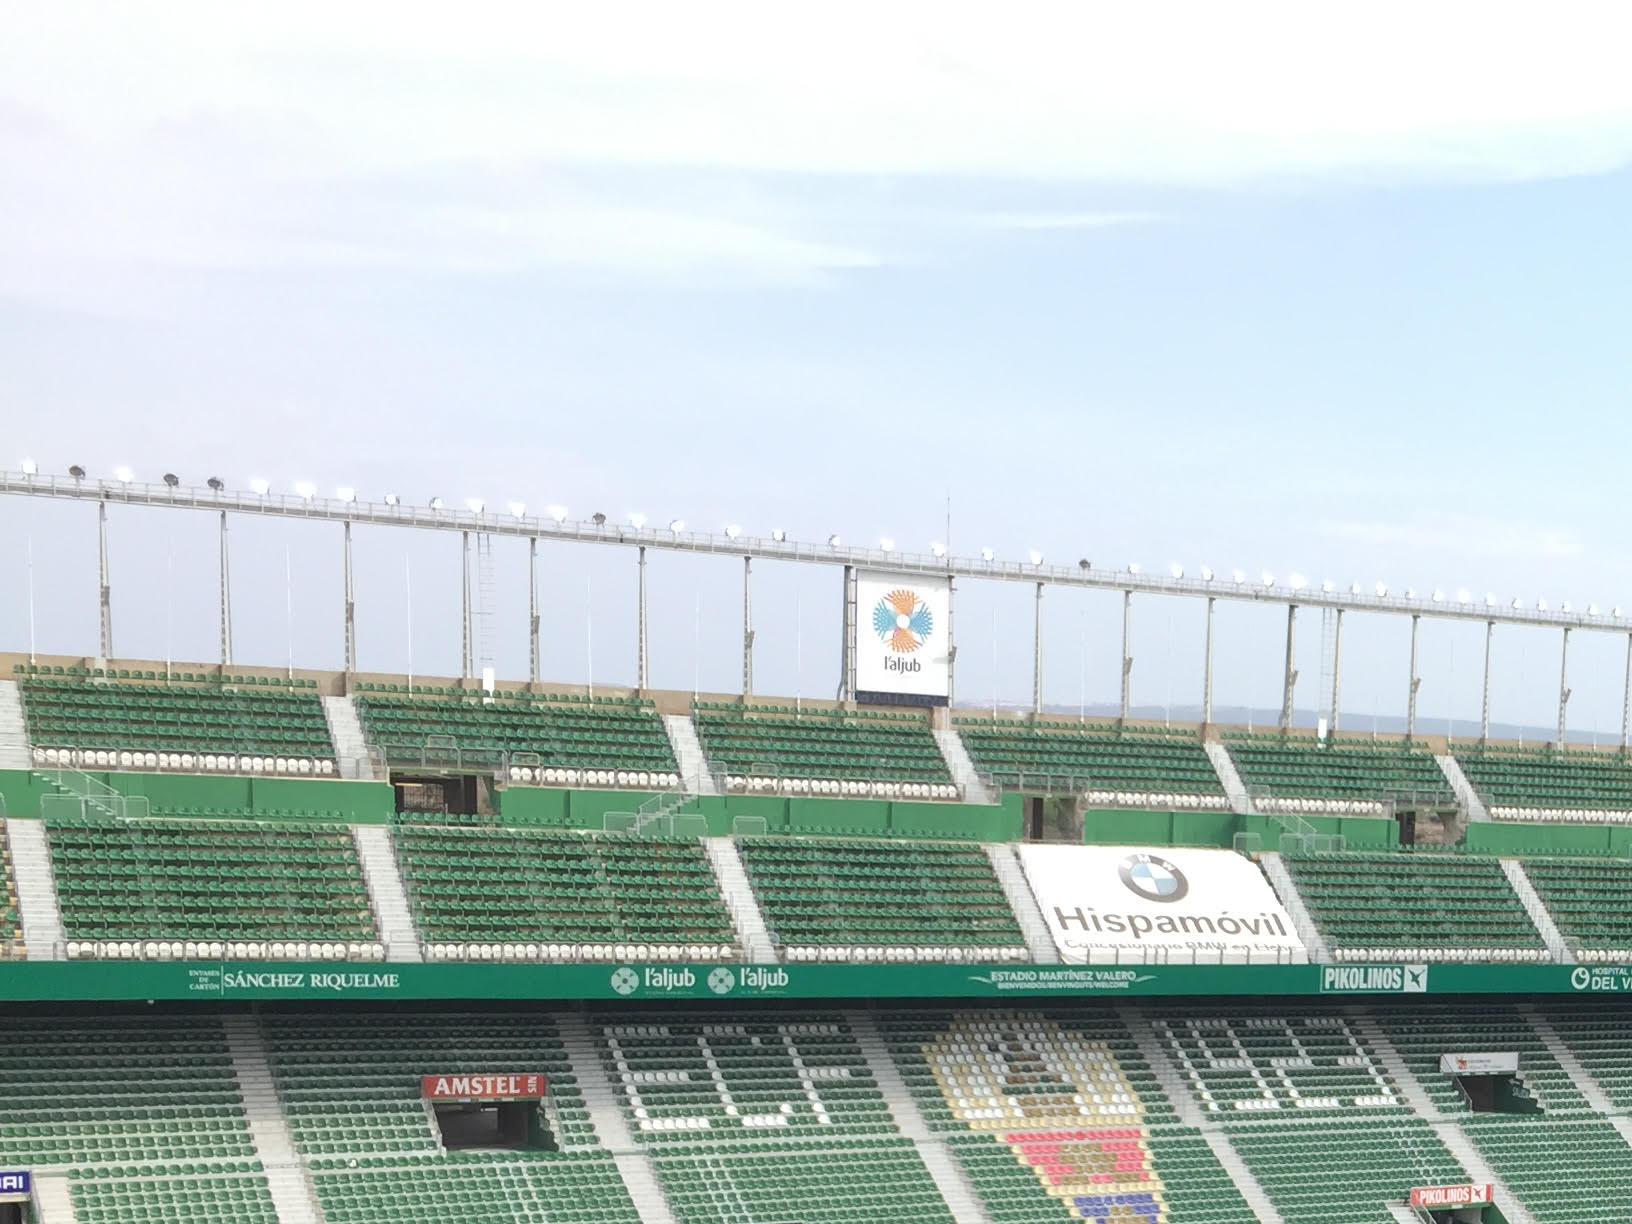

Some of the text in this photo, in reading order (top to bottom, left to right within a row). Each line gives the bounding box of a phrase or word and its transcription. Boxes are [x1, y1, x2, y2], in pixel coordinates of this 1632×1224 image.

[884, 655, 921, 675] l'aljub
[1053, 906, 1288, 939] Hispamóvil
[223, 970, 400, 990] SÁNCHEZ RIQUELME
[645, 967, 696, 991] l'aljub
[741, 967, 789, 991] l'aljub
[991, 969, 1137, 982] ESTADIO MARTÍNEZ VALERO
[1324, 967, 1402, 990] PIKOLINOS
[1592, 967, 1628, 976] HOSPITAL
[1591, 977, 1618, 990] DEL
[434, 1076, 520, 1096] AMSTEL
[1420, 1187, 1470, 1205] PIKOLINOS
